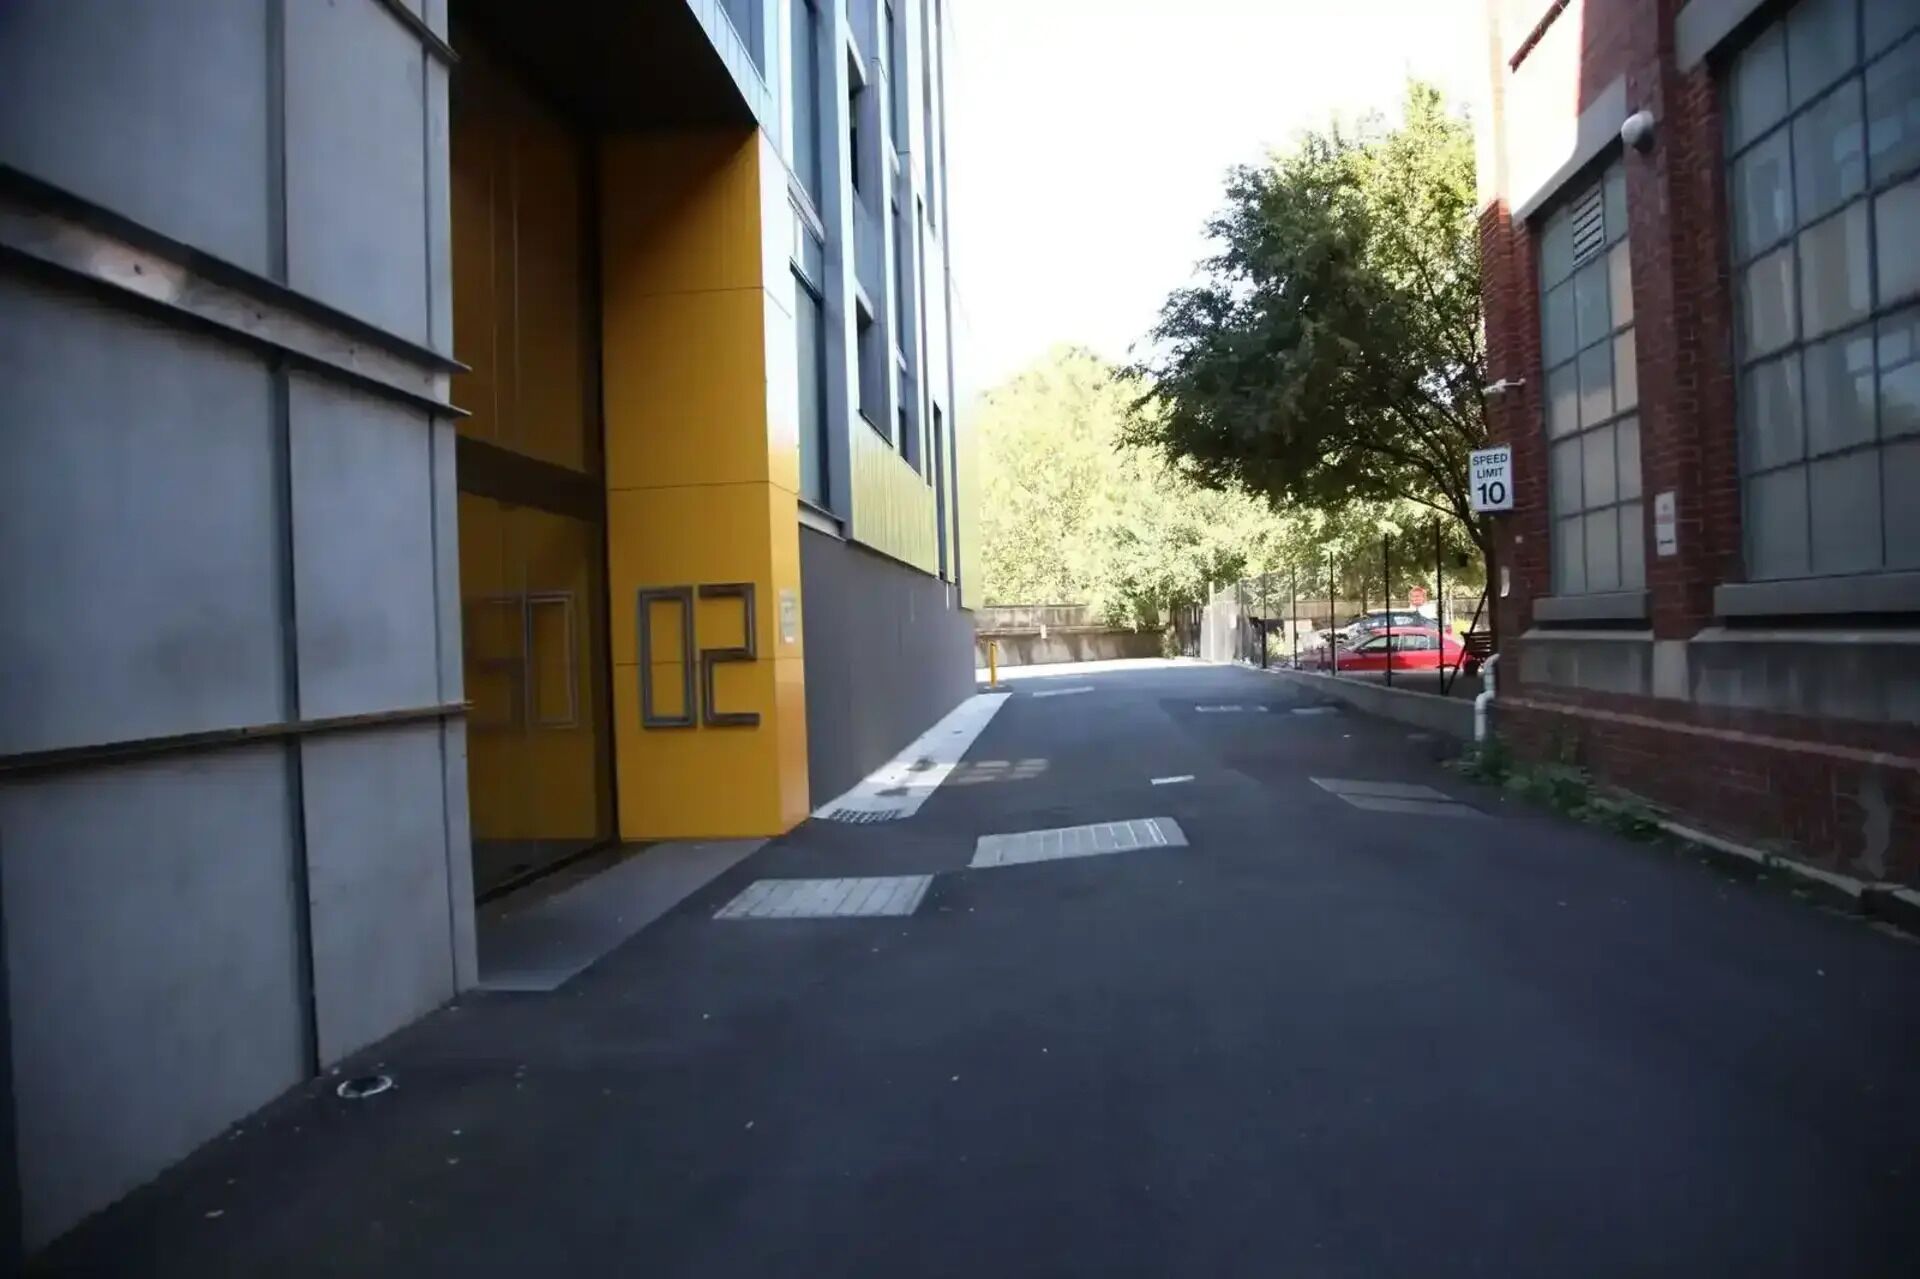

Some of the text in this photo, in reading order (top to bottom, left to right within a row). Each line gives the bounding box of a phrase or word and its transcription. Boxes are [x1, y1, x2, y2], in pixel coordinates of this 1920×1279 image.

[1472, 453, 1508, 466] SPEED
[1476, 467, 1504, 479] LIMIT
[1477, 481, 1506, 505] 10
[638, 582, 761, 729] 02
